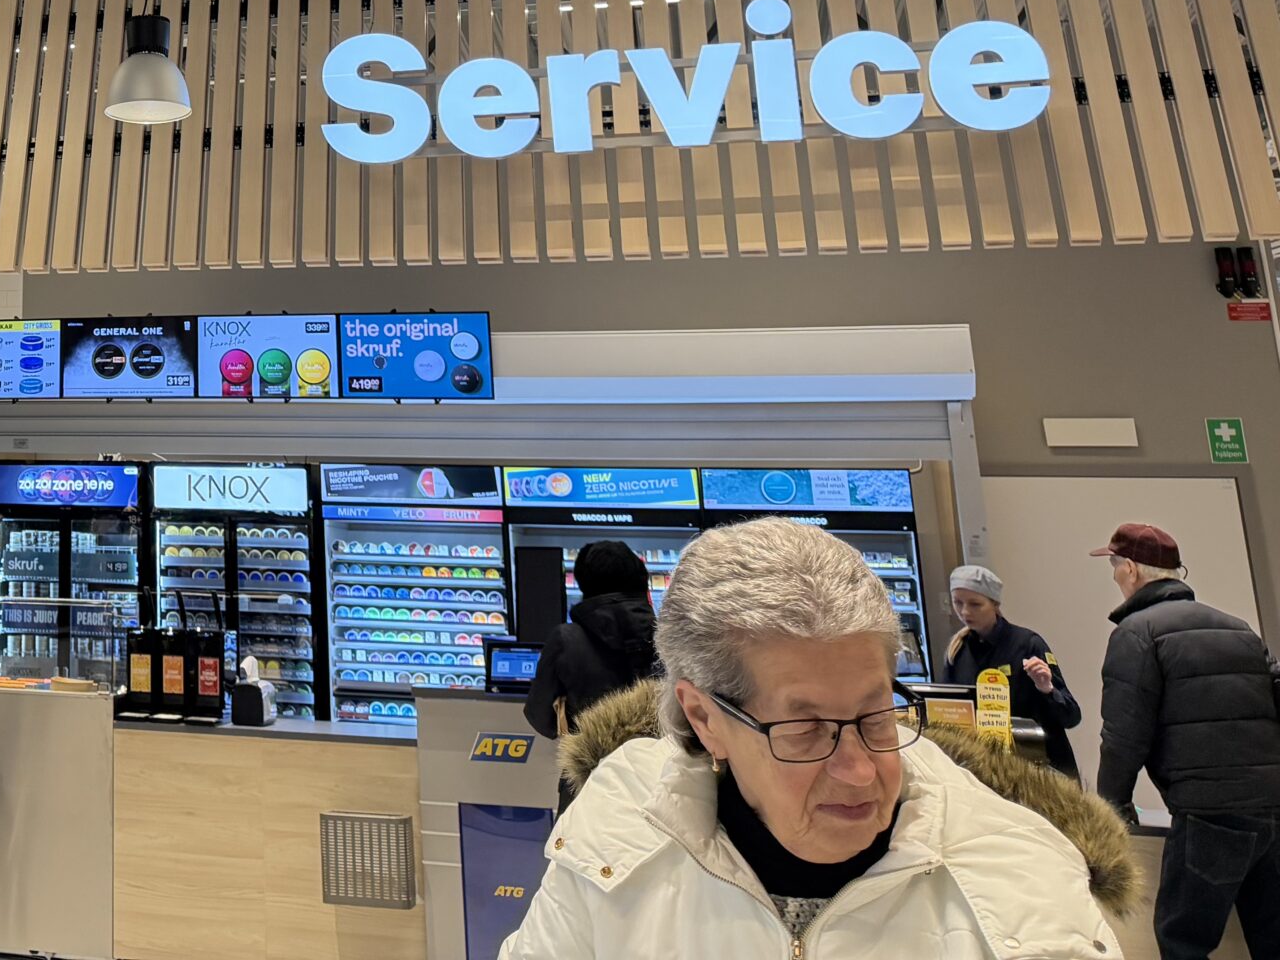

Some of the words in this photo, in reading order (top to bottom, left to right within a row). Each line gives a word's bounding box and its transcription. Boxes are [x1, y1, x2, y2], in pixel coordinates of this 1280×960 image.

[93, 328, 139, 336] GENERAL
[142, 327, 163, 335] ONE
[204, 321, 251, 337] KNOX
[345, 319, 379, 337] the
[383, 318, 458, 340] original
[583, 472, 612, 483] NEW
[52, 480, 84, 491] zone
[188, 474, 270, 504] KNOX
[584, 482, 616, 494] ZERO
[619, 478, 678, 491] NICOTINE
[337, 508, 369, 517] MINTY
[443, 510, 480, 520] FRUITY
[572, 513, 607, 522] TOBACCO
[8, 557, 44, 571] skruf.
[4, 609, 22, 623] THIS
[24, 610, 32, 623] IS
[33, 610, 58, 624] JUICY
[474, 738, 528, 758] ATG
[494, 886, 524, 898] ATG
